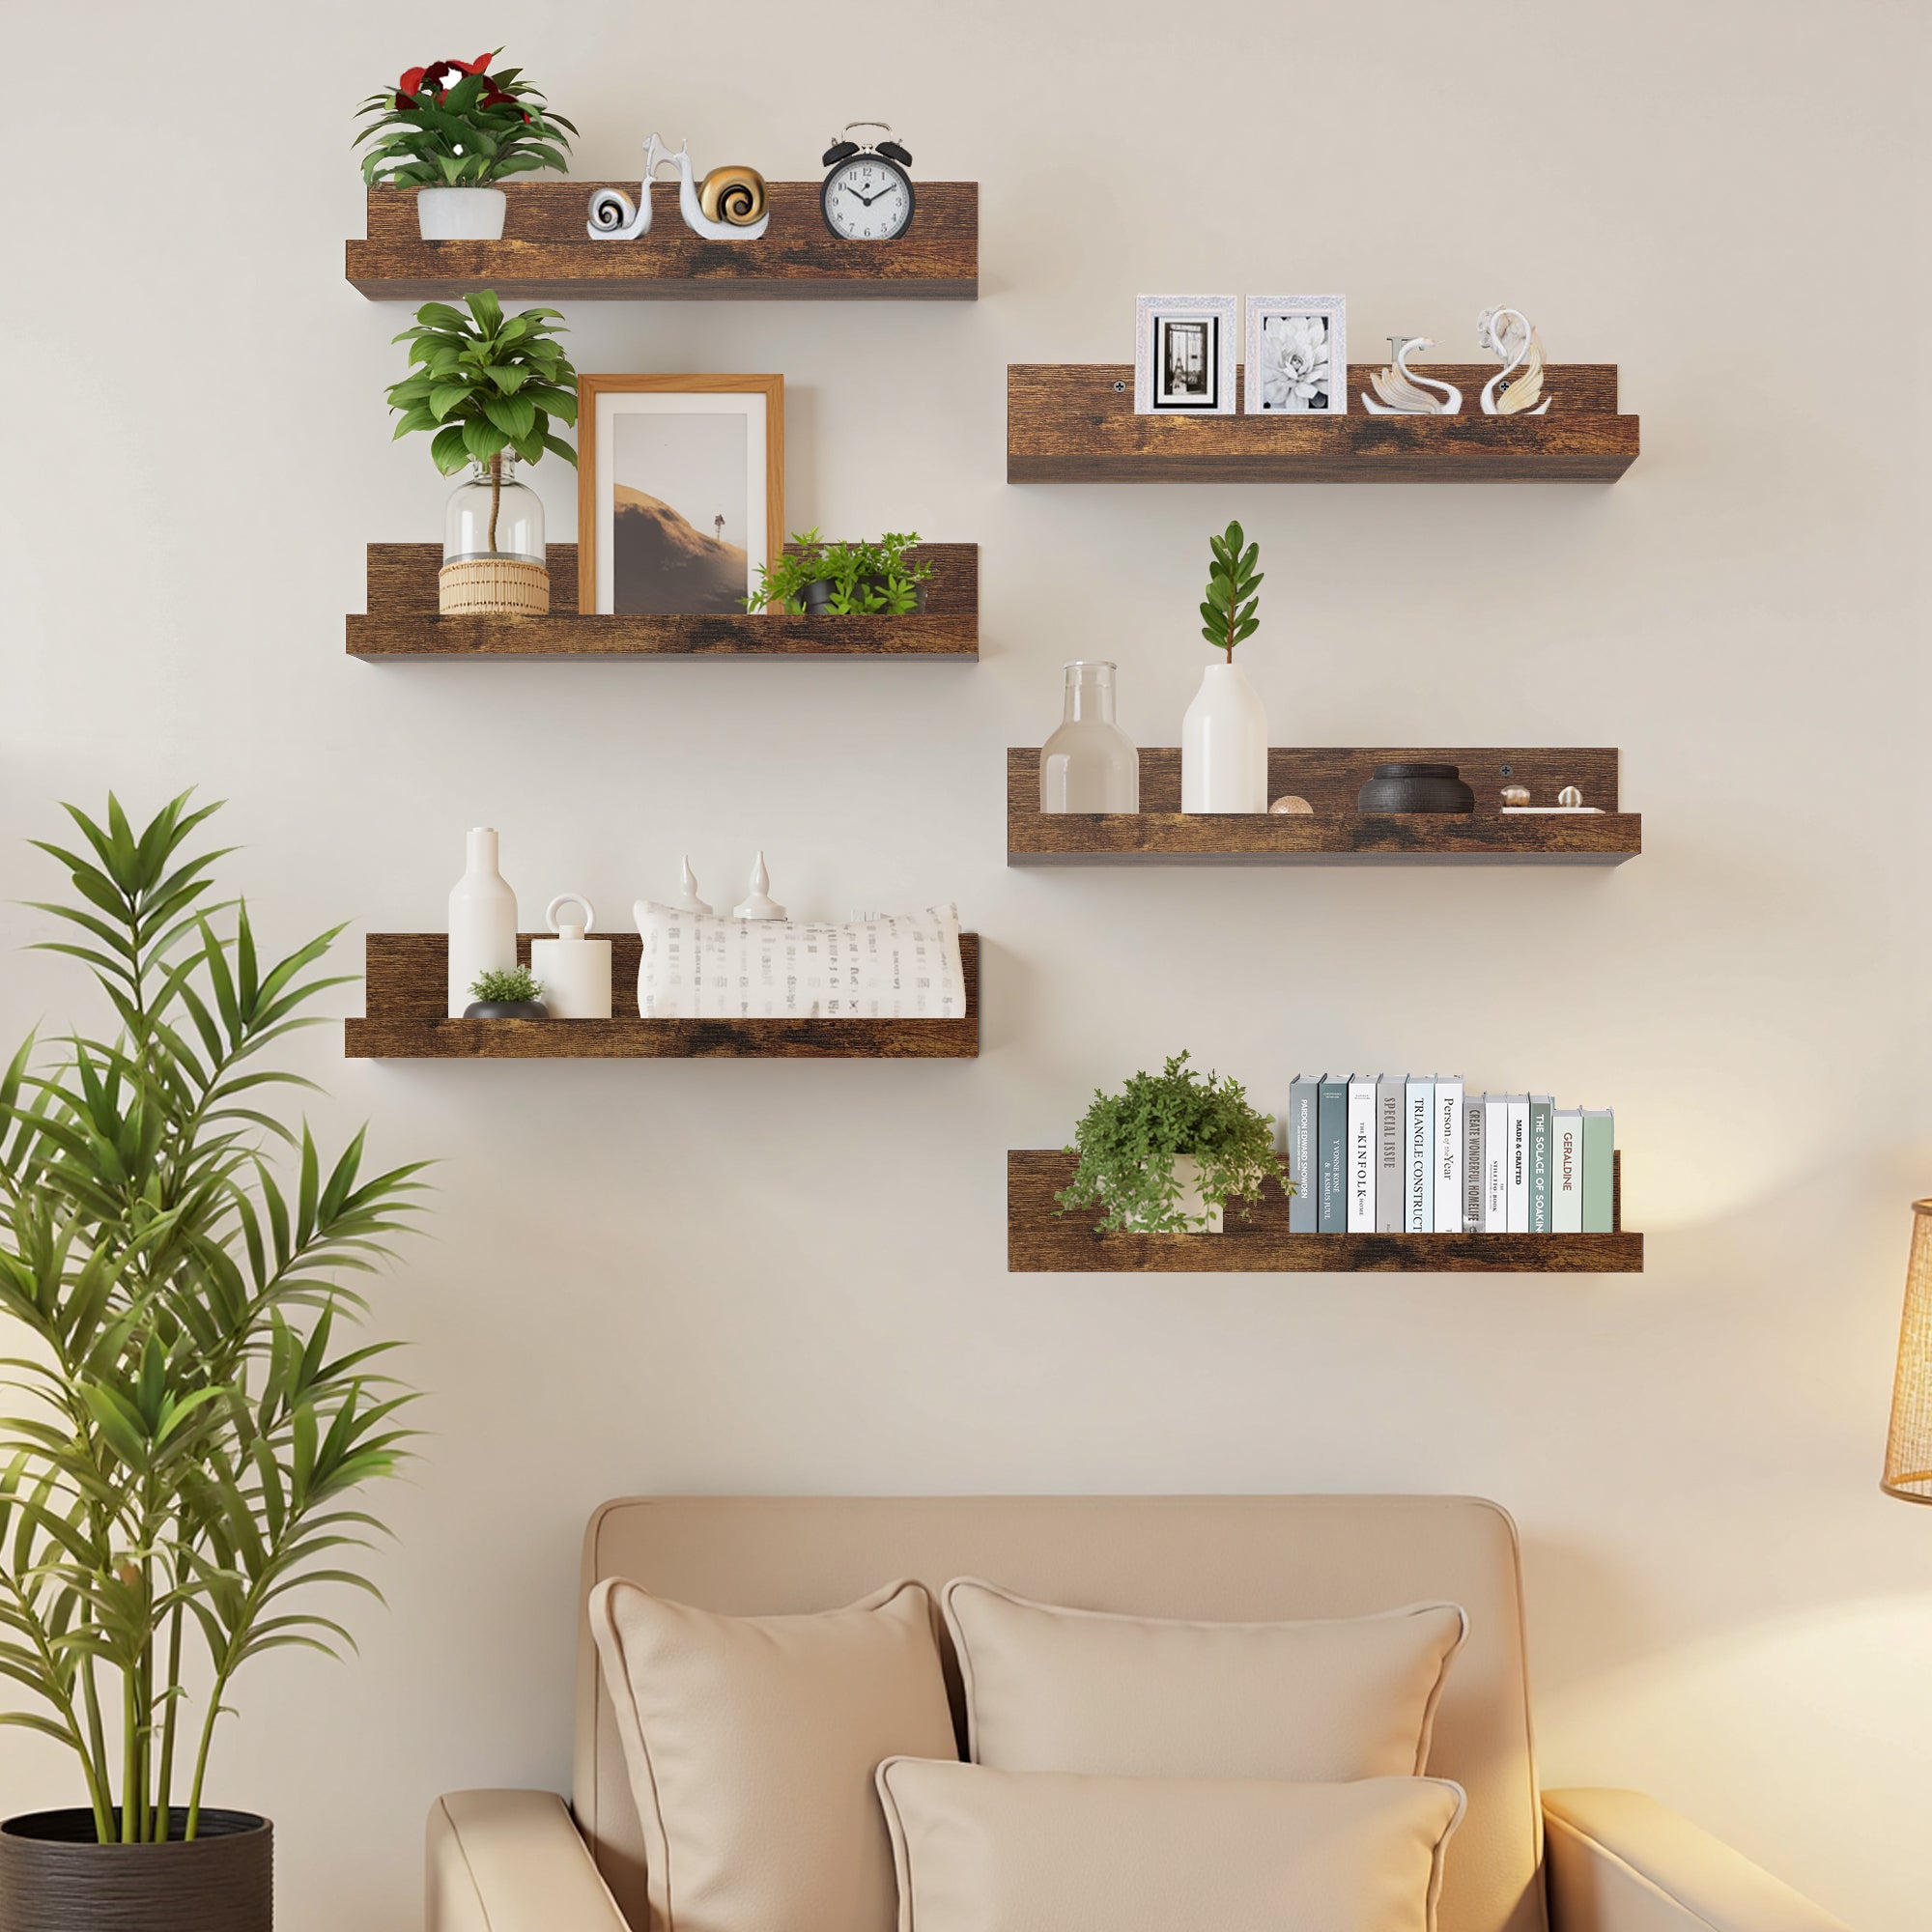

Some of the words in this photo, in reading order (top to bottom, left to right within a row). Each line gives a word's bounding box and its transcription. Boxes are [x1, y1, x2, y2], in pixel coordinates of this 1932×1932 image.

[849, 171, 857, 181] 11
[863, 167, 872, 177] 12
[838, 182, 847, 191] 10
[832, 197, 839, 207] 9
[895, 197, 902, 207] 3
[837, 213, 843, 221] 8
[848, 222, 855, 232] 7
[881, 223, 888, 233] 5
[891, 213, 897, 222] 4
[864, 228, 870, 237] 6
[1383, 1097, 1396, 1138] SPECIAL
[1413, 1097, 1424, 1158] TRIANGLE
[1443, 1098, 1454, 1137] Person
[1468, 1109, 1481, 1136] CREATE
[1536, 1114, 1545, 1133] THE
[1356, 1135, 1367, 1198] KINFOLK
[1383, 1142, 1396, 1169] ISSUE
[1468, 1138, 1480, 1183] WONDERFUL
[1536, 1136, 1545, 1175] SOLACE
[1562, 1132, 1573, 1191] GERALDINE
[1443, 1155, 1454, 1180] Year
[1536, 1178, 1545, 1191] OF
[1412, 1160, 1424, 1233] CONSTRUCT
[1468, 1185, 1480, 1221] HOMELIFE
